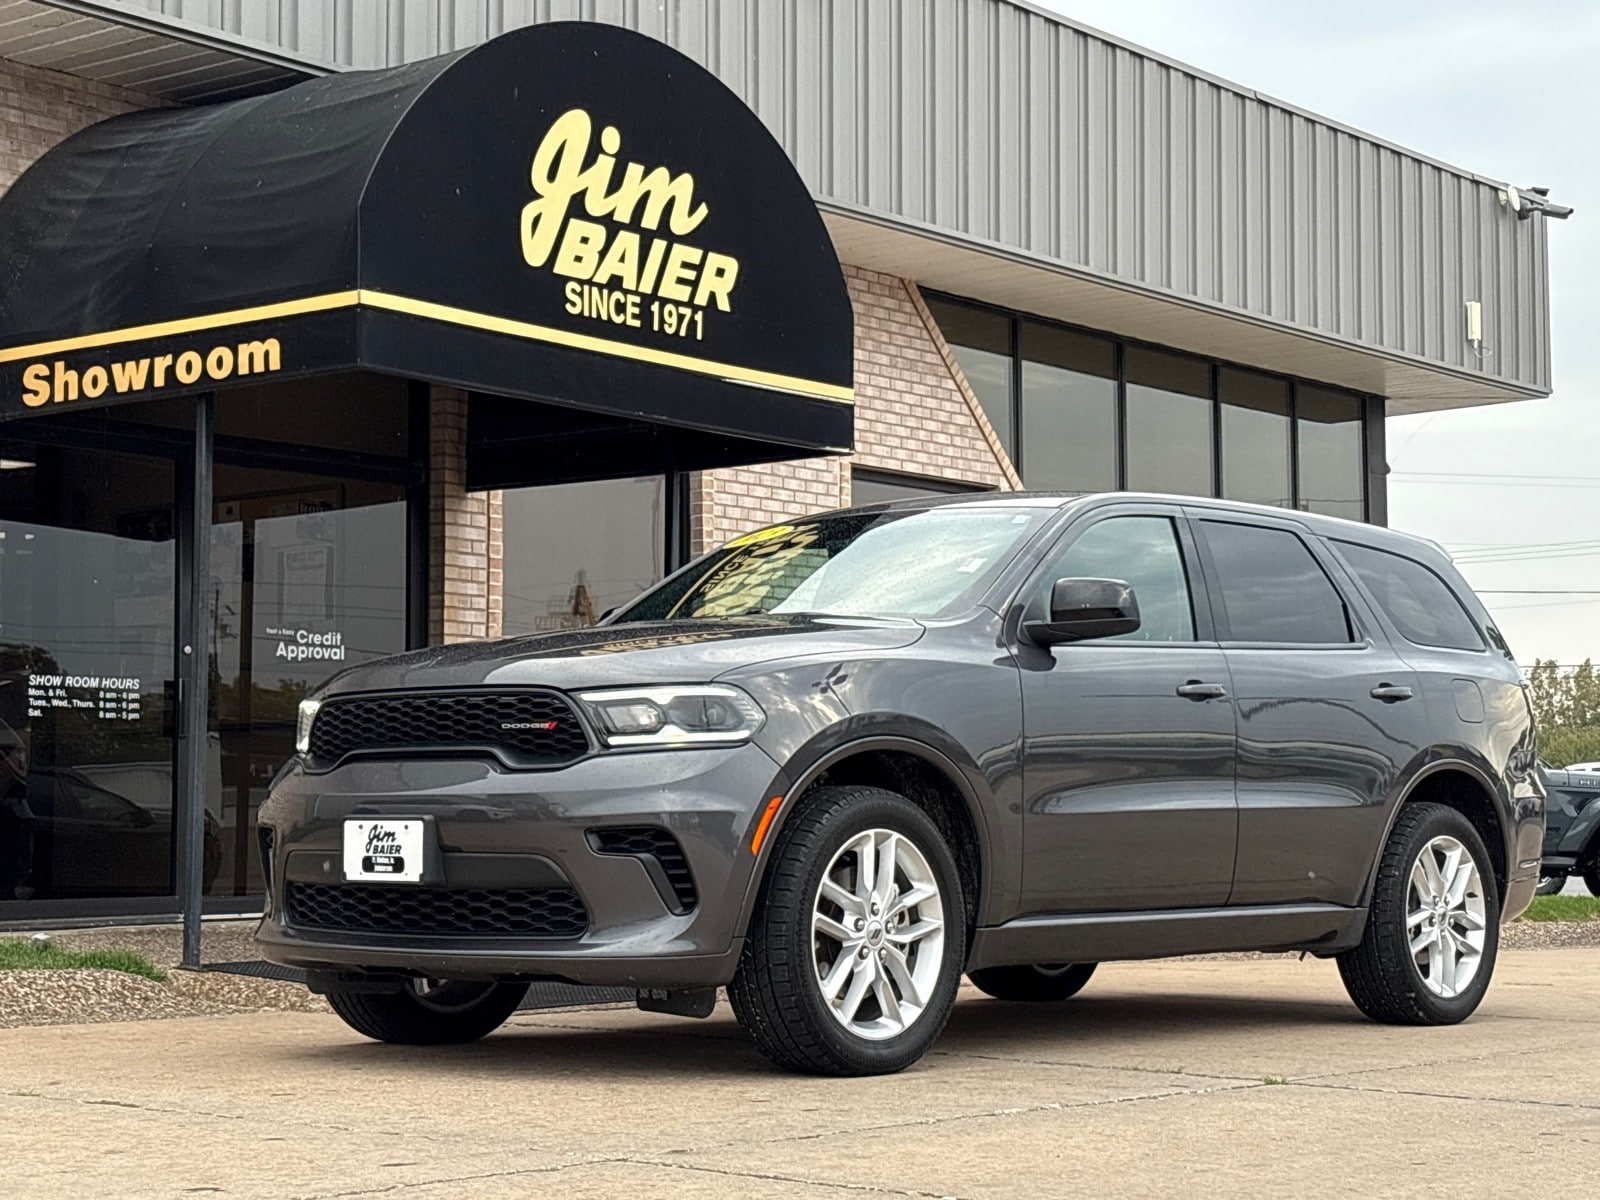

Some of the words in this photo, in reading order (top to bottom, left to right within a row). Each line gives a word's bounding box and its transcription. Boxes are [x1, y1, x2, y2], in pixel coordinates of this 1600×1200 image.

[521, 108, 709, 268] Jim
[552, 217, 739, 313] BAIER
[564, 281, 642, 328] SINCE
[650, 300, 704, 341] 1971
[22, 338, 281, 407] Showroom
[296, 629, 342, 646] Credit
[275, 641, 345, 662] Approval
[28, 674, 63, 687] SHOW
[65, 675, 100, 688] ROOM
[101, 677, 140, 690] HOURS
[28, 688, 47, 697] Mon.
[55, 688, 68, 697] Fri.
[128, 692, 140, 700] pm
[72, 699, 96, 708] Thurs.
[128, 702, 140, 710] pm
[28, 708, 43, 717] Sat.
[128, 713, 140, 721] pm
[365, 823, 397, 854] Jim
[372, 844, 402, 855] BAIER
